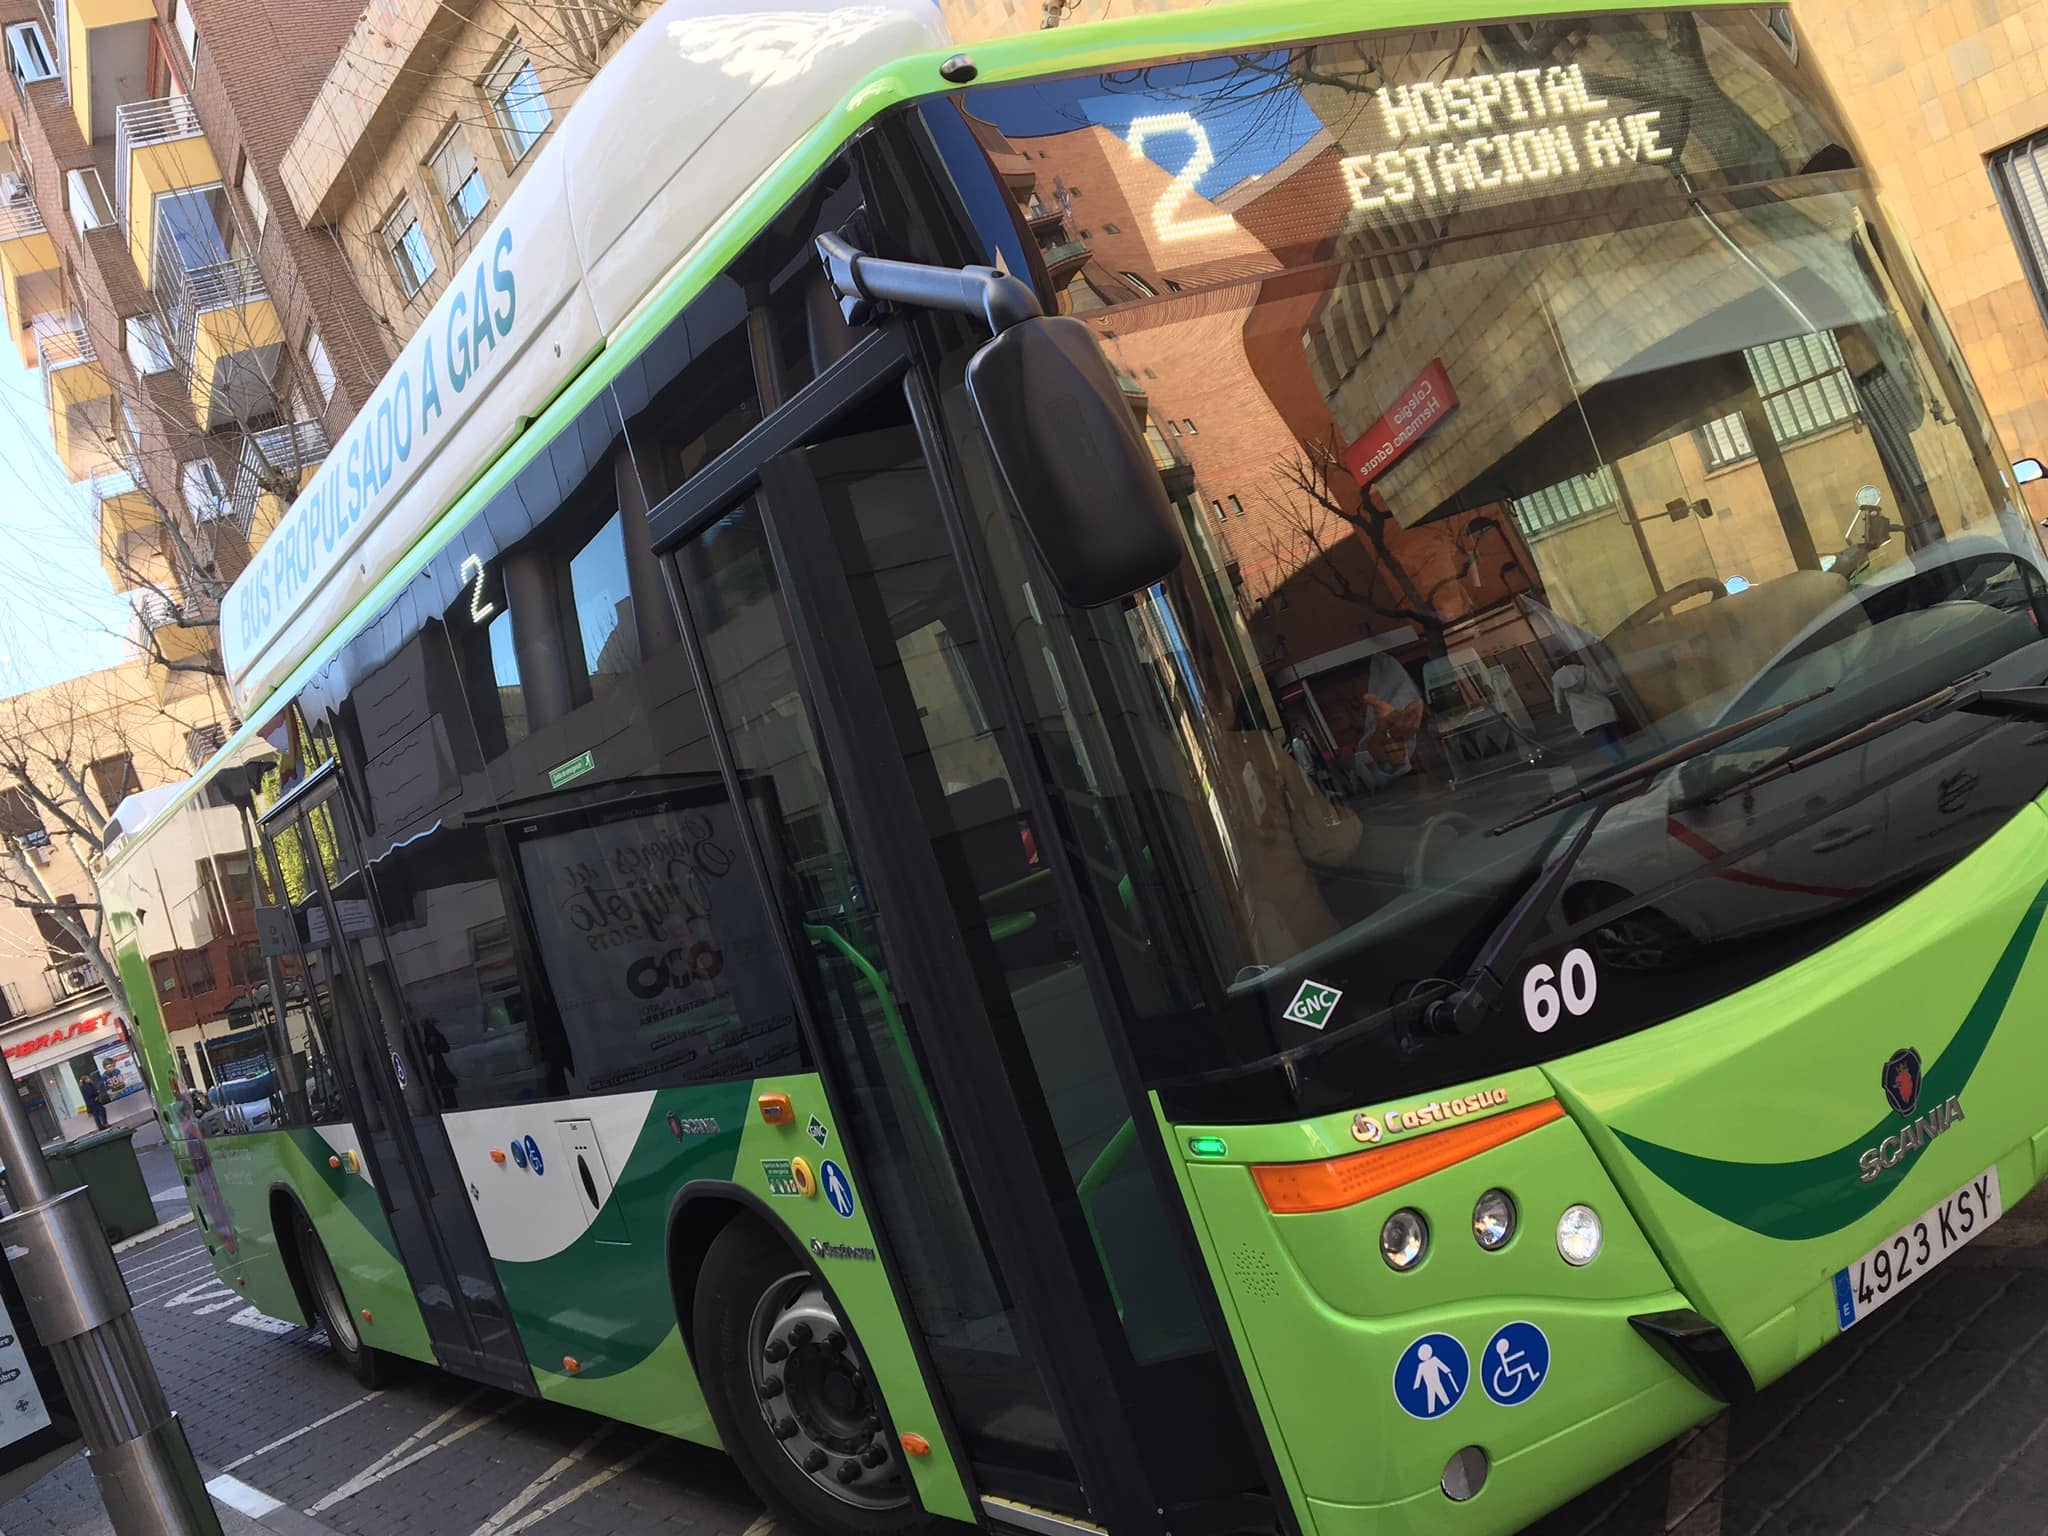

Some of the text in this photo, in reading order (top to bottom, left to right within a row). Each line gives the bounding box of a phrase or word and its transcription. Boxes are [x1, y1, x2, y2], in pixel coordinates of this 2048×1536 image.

[1376, 63, 1607, 138] HOSPITAL
[1126, 111, 1237, 243] 2
[1341, 111, 1673, 209] ESTACION AVE
[240, 227, 516, 652] BUS PROPULSADO A GAS
[461, 553, 493, 623] 2
[1294, 990, 1333, 1019] GNC
[1523, 948, 1597, 1033] 60
[809, 1125, 826, 1137] GNC
[1384, 1088, 1508, 1133] Castrosua
[1859, 1095, 1965, 1183] SCANIA
[1857, 1175, 1989, 1305] 4923 KSY
[1843, 1302, 1851, 1317] E
